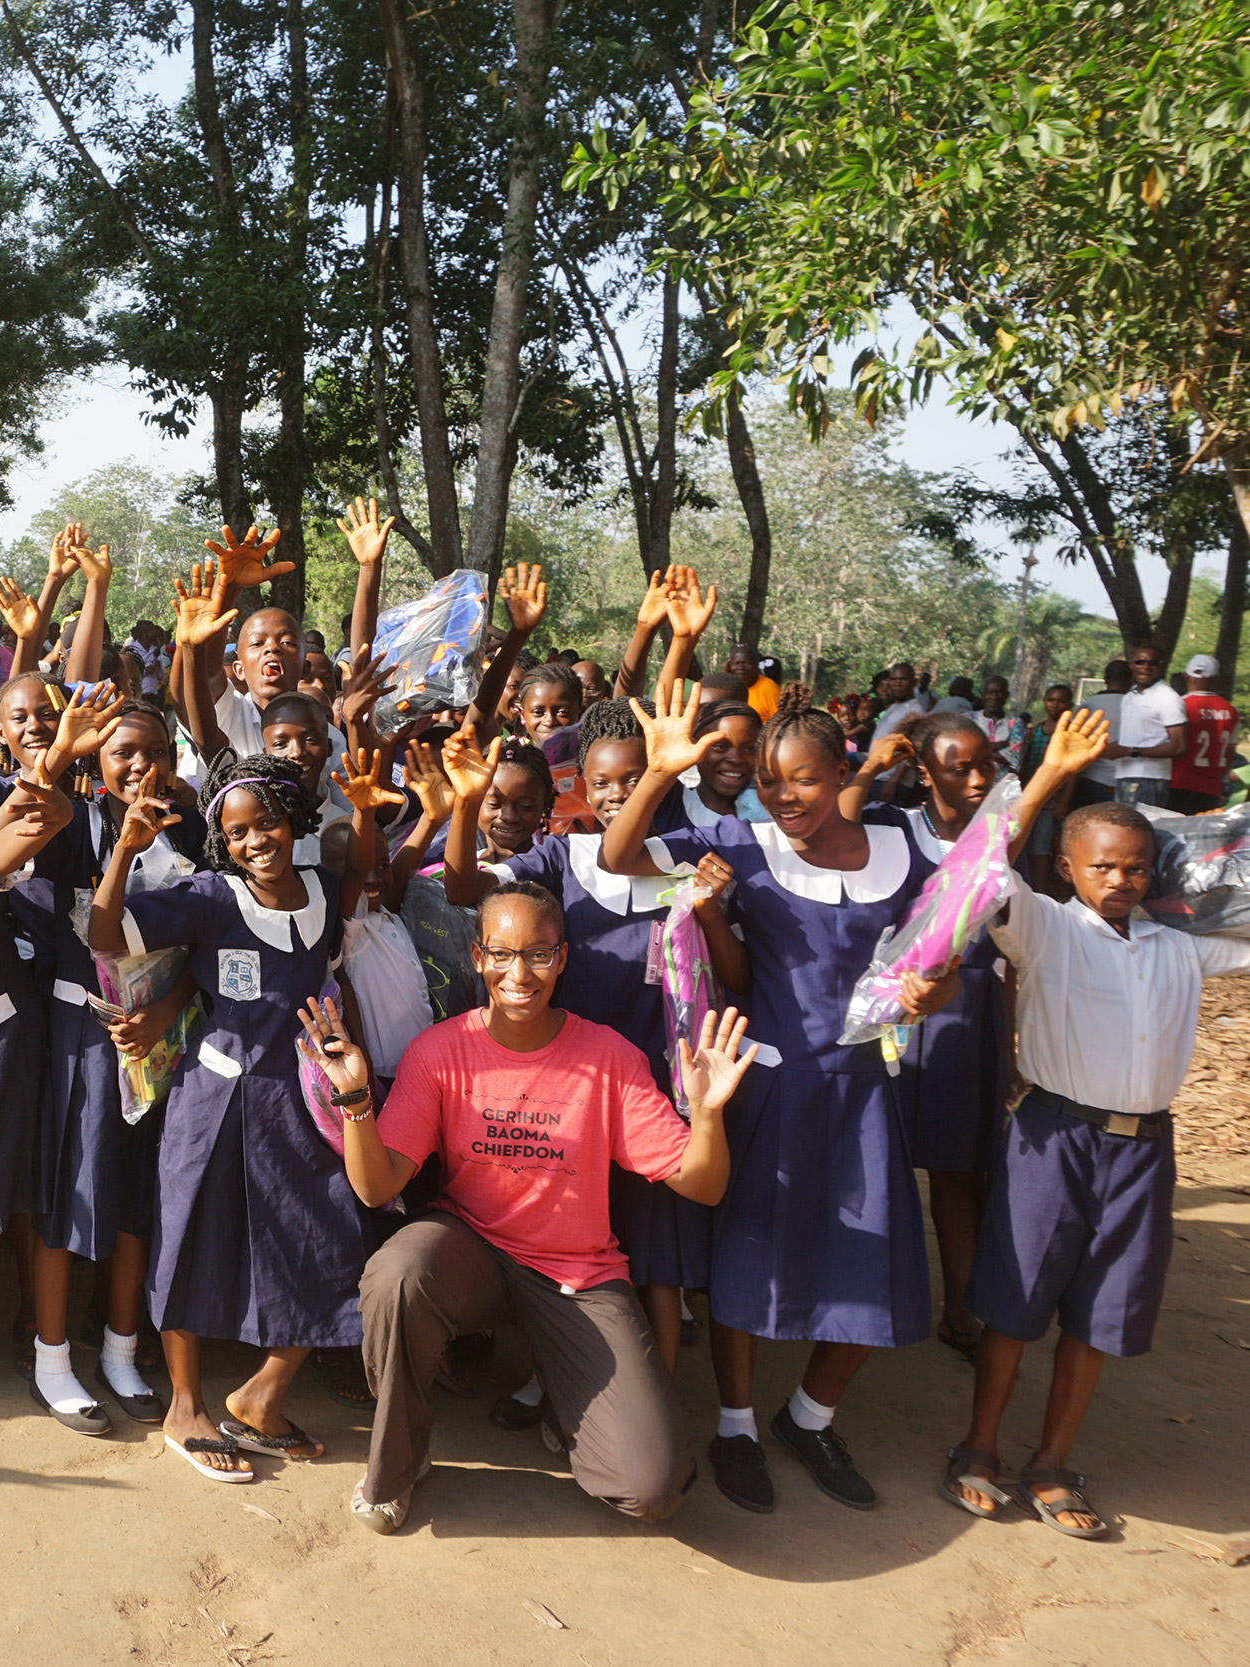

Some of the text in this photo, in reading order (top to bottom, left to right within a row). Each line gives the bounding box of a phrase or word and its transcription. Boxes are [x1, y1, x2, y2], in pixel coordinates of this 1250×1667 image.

[482, 1108, 561, 1125] GERIHUN
[486, 1125, 551, 1142] BAOMA
[471, 1141, 564, 1161] CHIEFDOM
